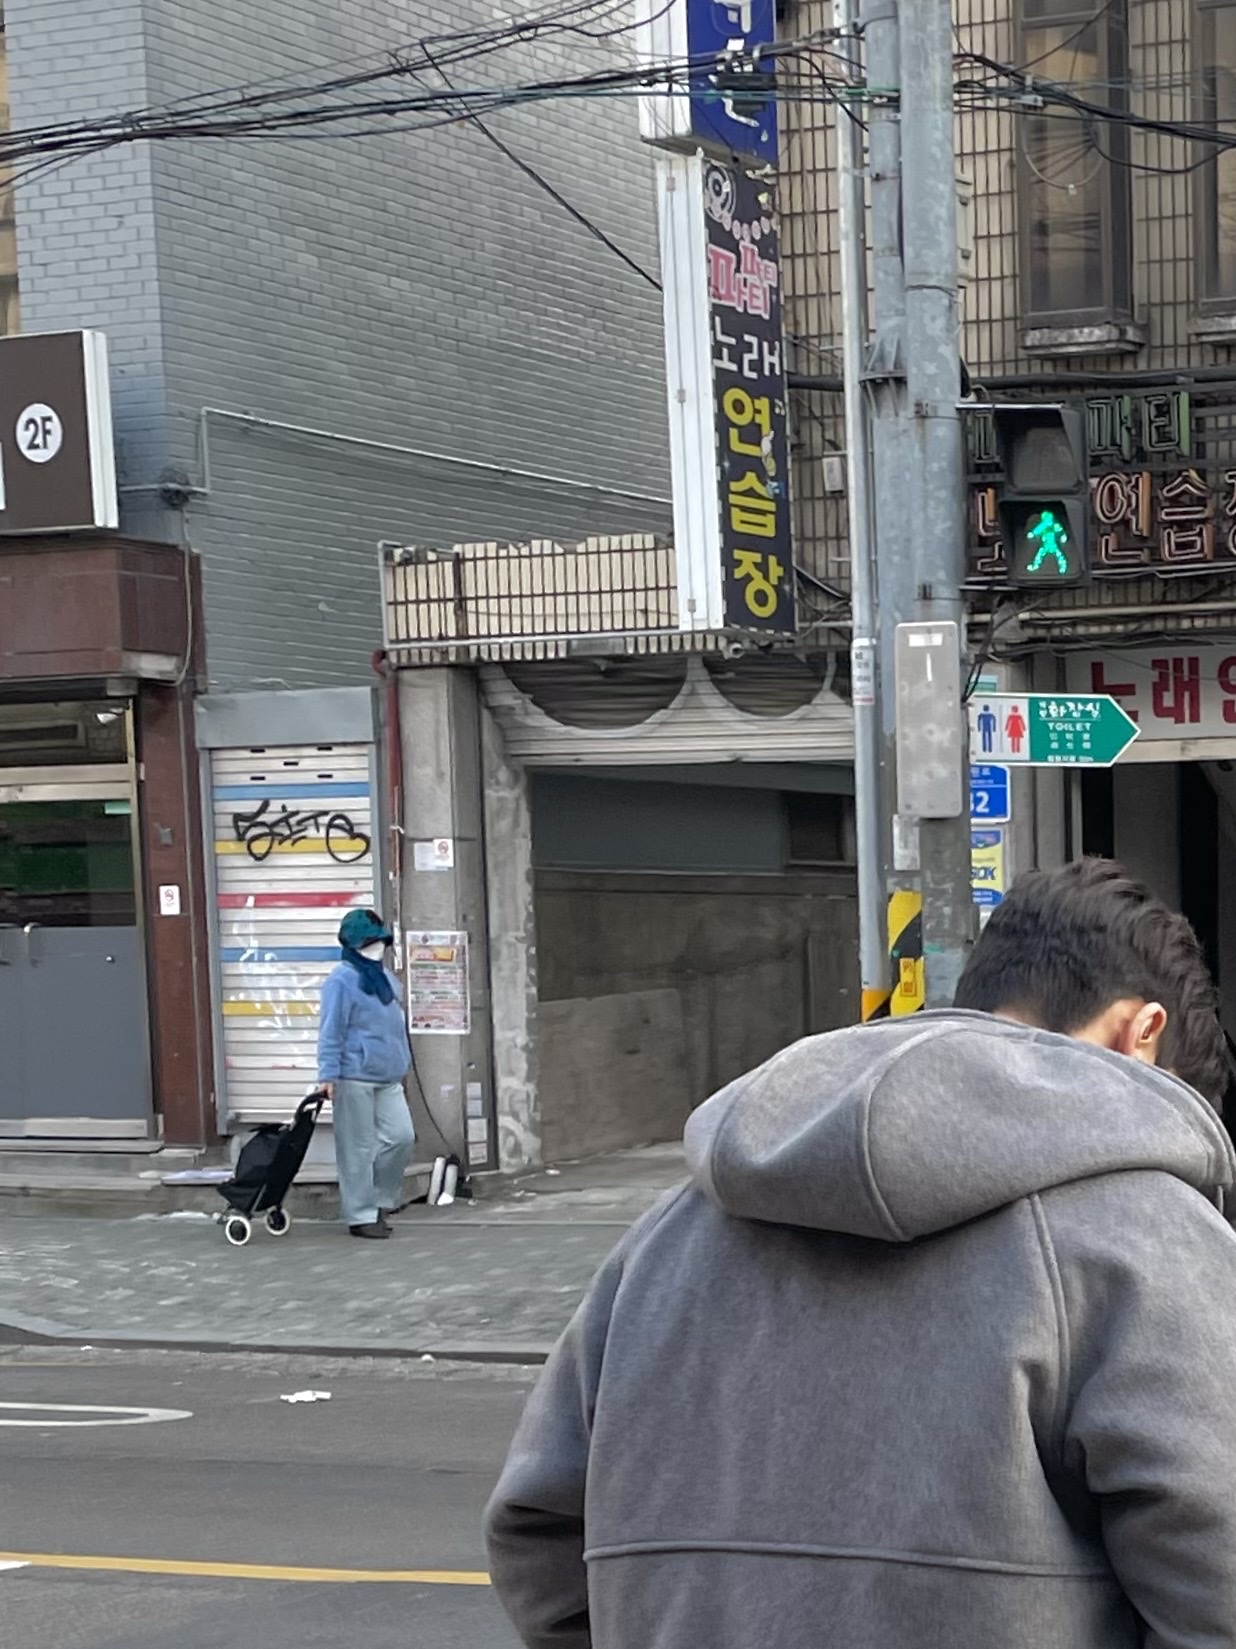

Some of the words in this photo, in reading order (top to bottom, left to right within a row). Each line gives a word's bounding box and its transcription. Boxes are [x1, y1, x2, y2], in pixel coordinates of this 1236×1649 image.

[712, 315, 782, 379] 노래
[24, 415, 53, 451] 2F
[721, 386, 785, 618] 연습장
[1047, 722, 1092, 732] TOILET
